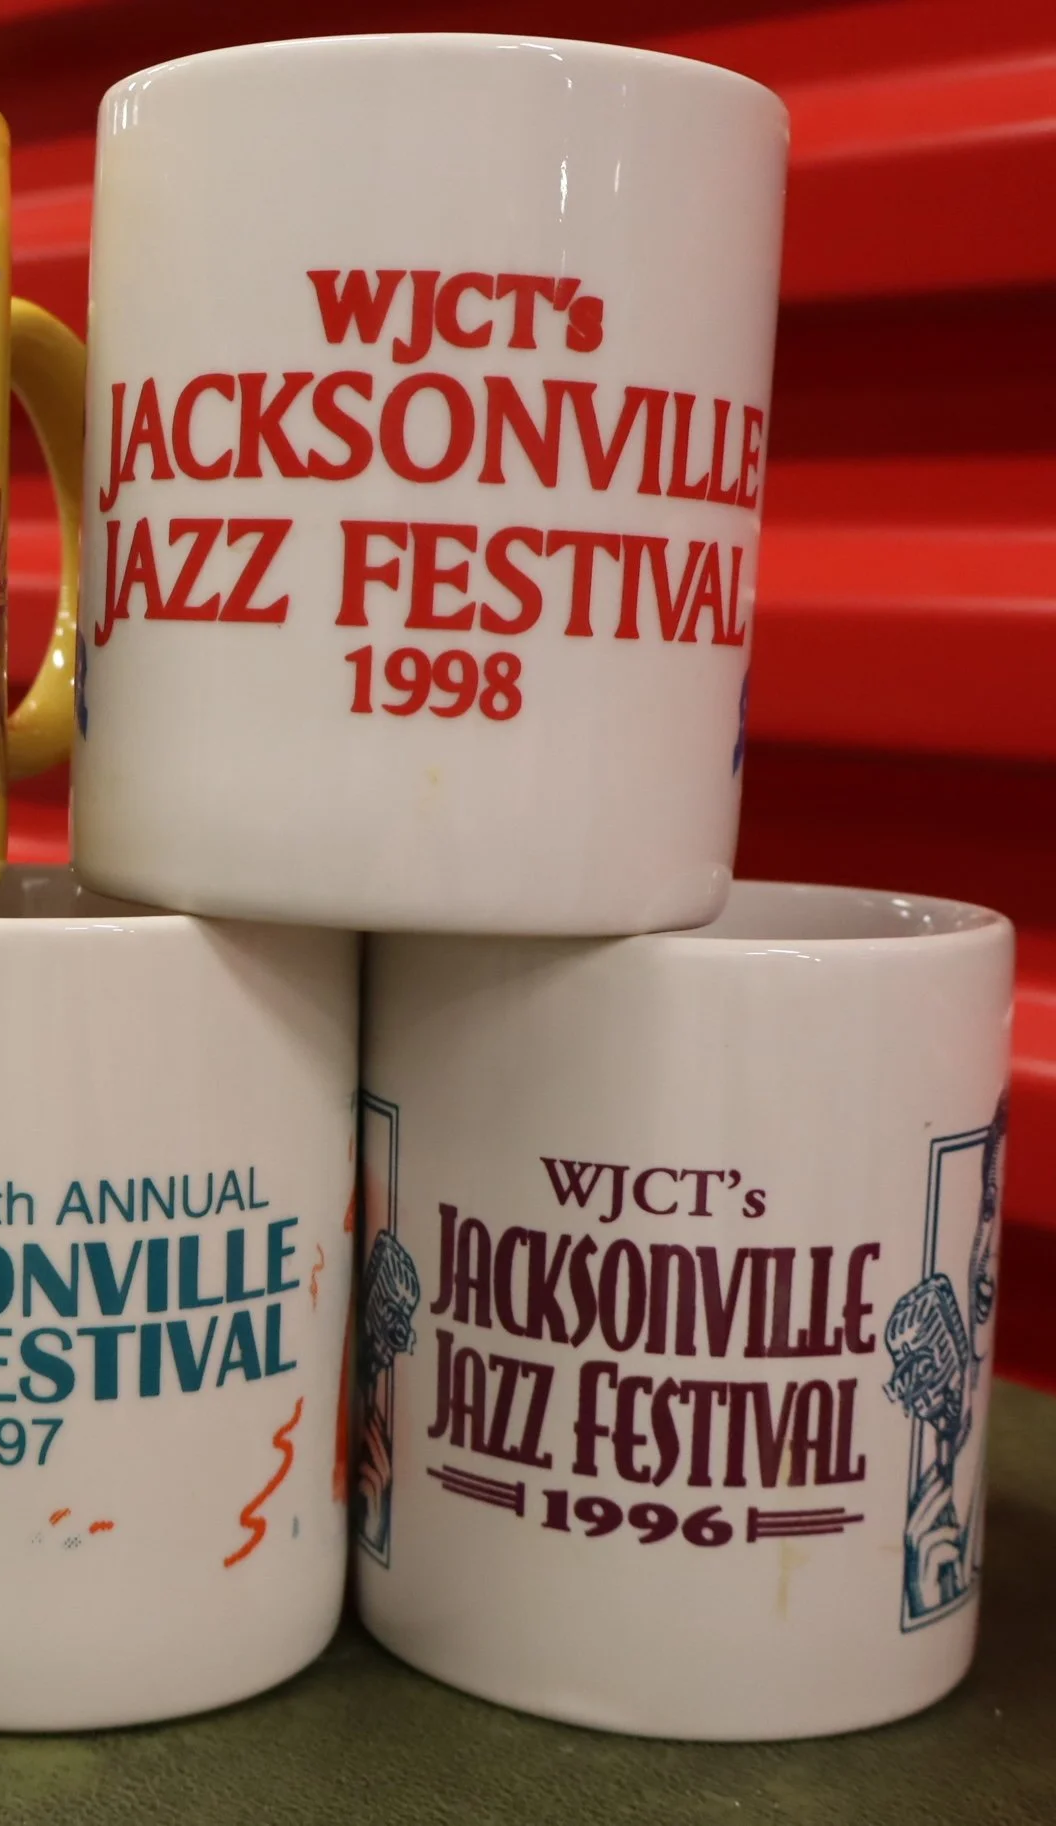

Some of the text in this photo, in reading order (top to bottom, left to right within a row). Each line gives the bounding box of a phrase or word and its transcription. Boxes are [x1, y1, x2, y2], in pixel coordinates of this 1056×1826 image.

[307, 268, 604, 365] WJCT's
[99, 371, 763, 513] JACKSONVILLE
[95, 517, 745, 647] JAZZ FESTIVAL
[344, 645, 523, 721] 1998
[56, 1166, 270, 1226] ANNUAL
[540, 1157, 767, 1223] WJCT's
[430, 1202, 881, 1359] JACKSONVILLE
[427, 1328, 866, 1489] JAZZ FESTIVAL
[541, 1489, 734, 1548] 1996
